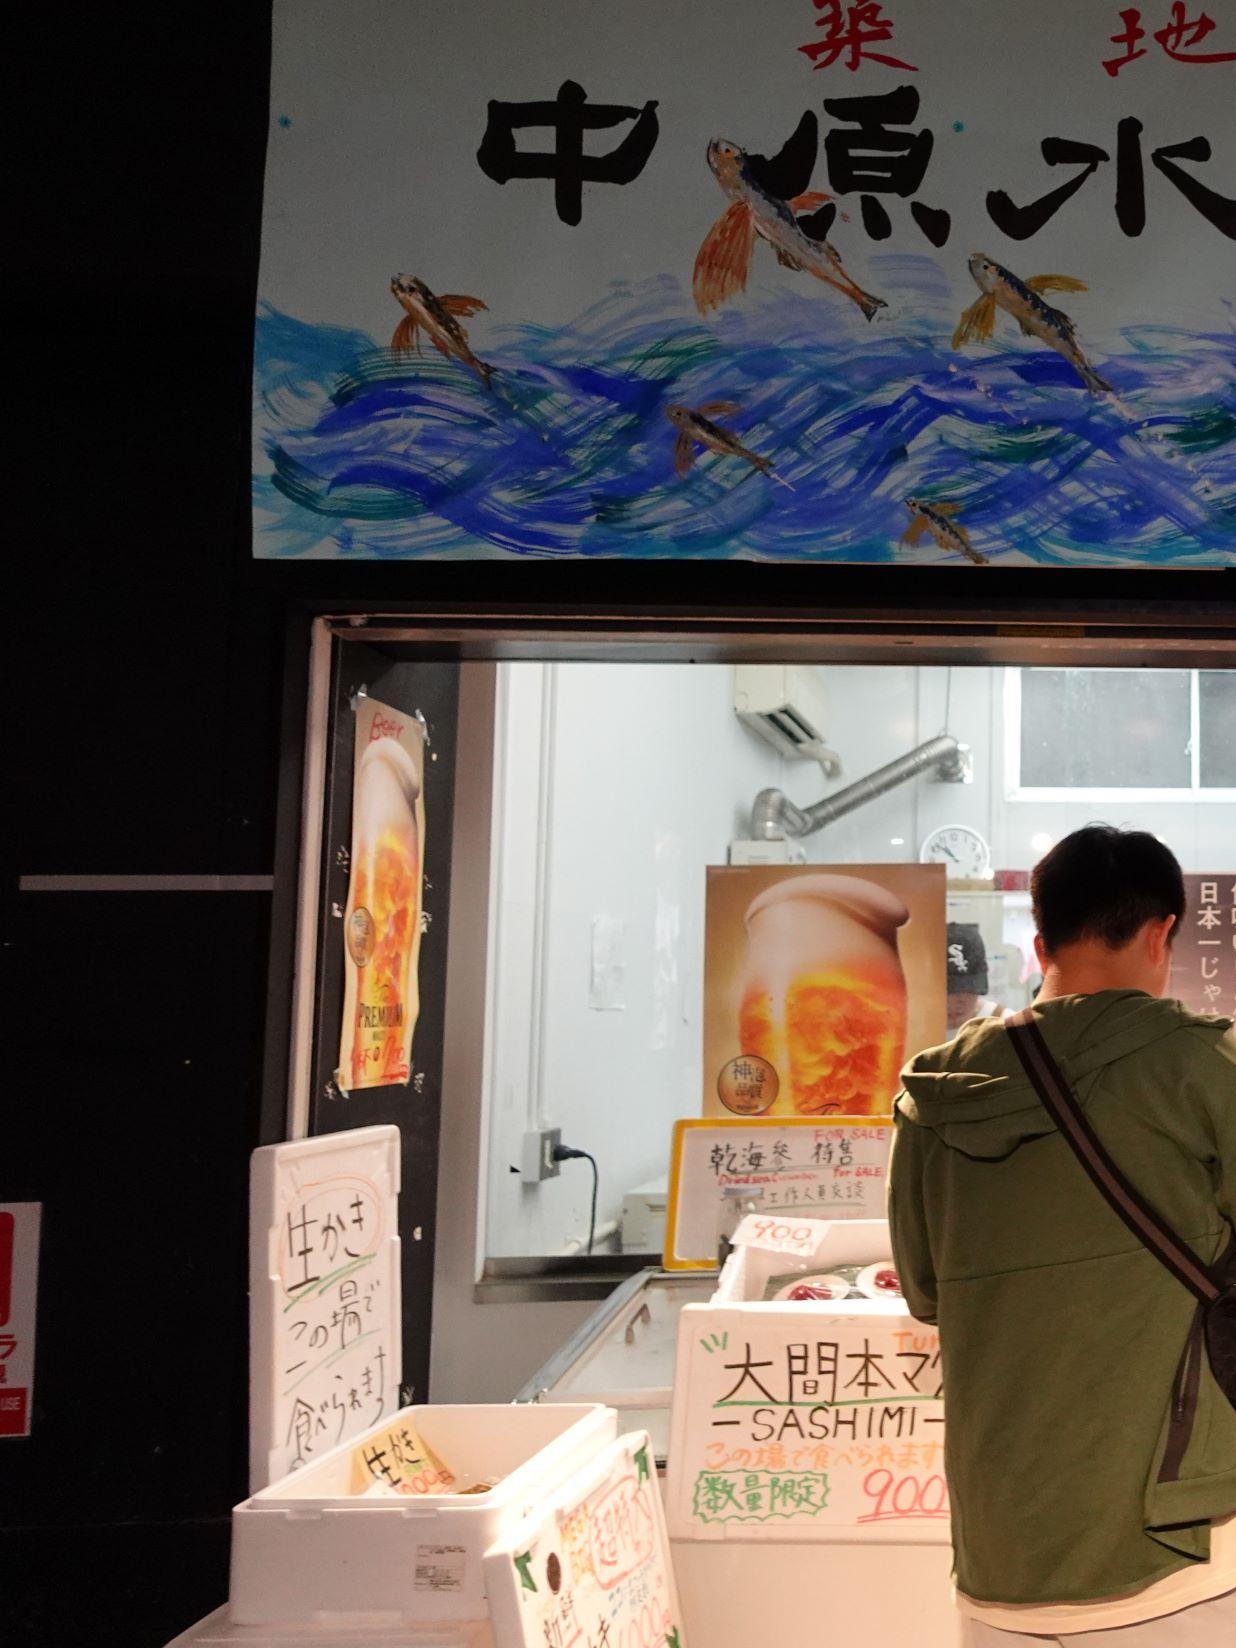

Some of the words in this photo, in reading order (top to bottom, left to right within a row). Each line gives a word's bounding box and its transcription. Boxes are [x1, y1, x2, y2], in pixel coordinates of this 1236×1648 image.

[1197, 881, 1222, 1016] 日本一じゃ
[814, 1129, 843, 1142] FOR
[849, 1128, 886, 1141] SALE
[286, 1199, 365, 1291] 生かき
[285, 1279, 381, 1375] この場で
[285, 1346, 388, 1454] 食べられます
[702, 1472, 821, 1513] 数量限定
